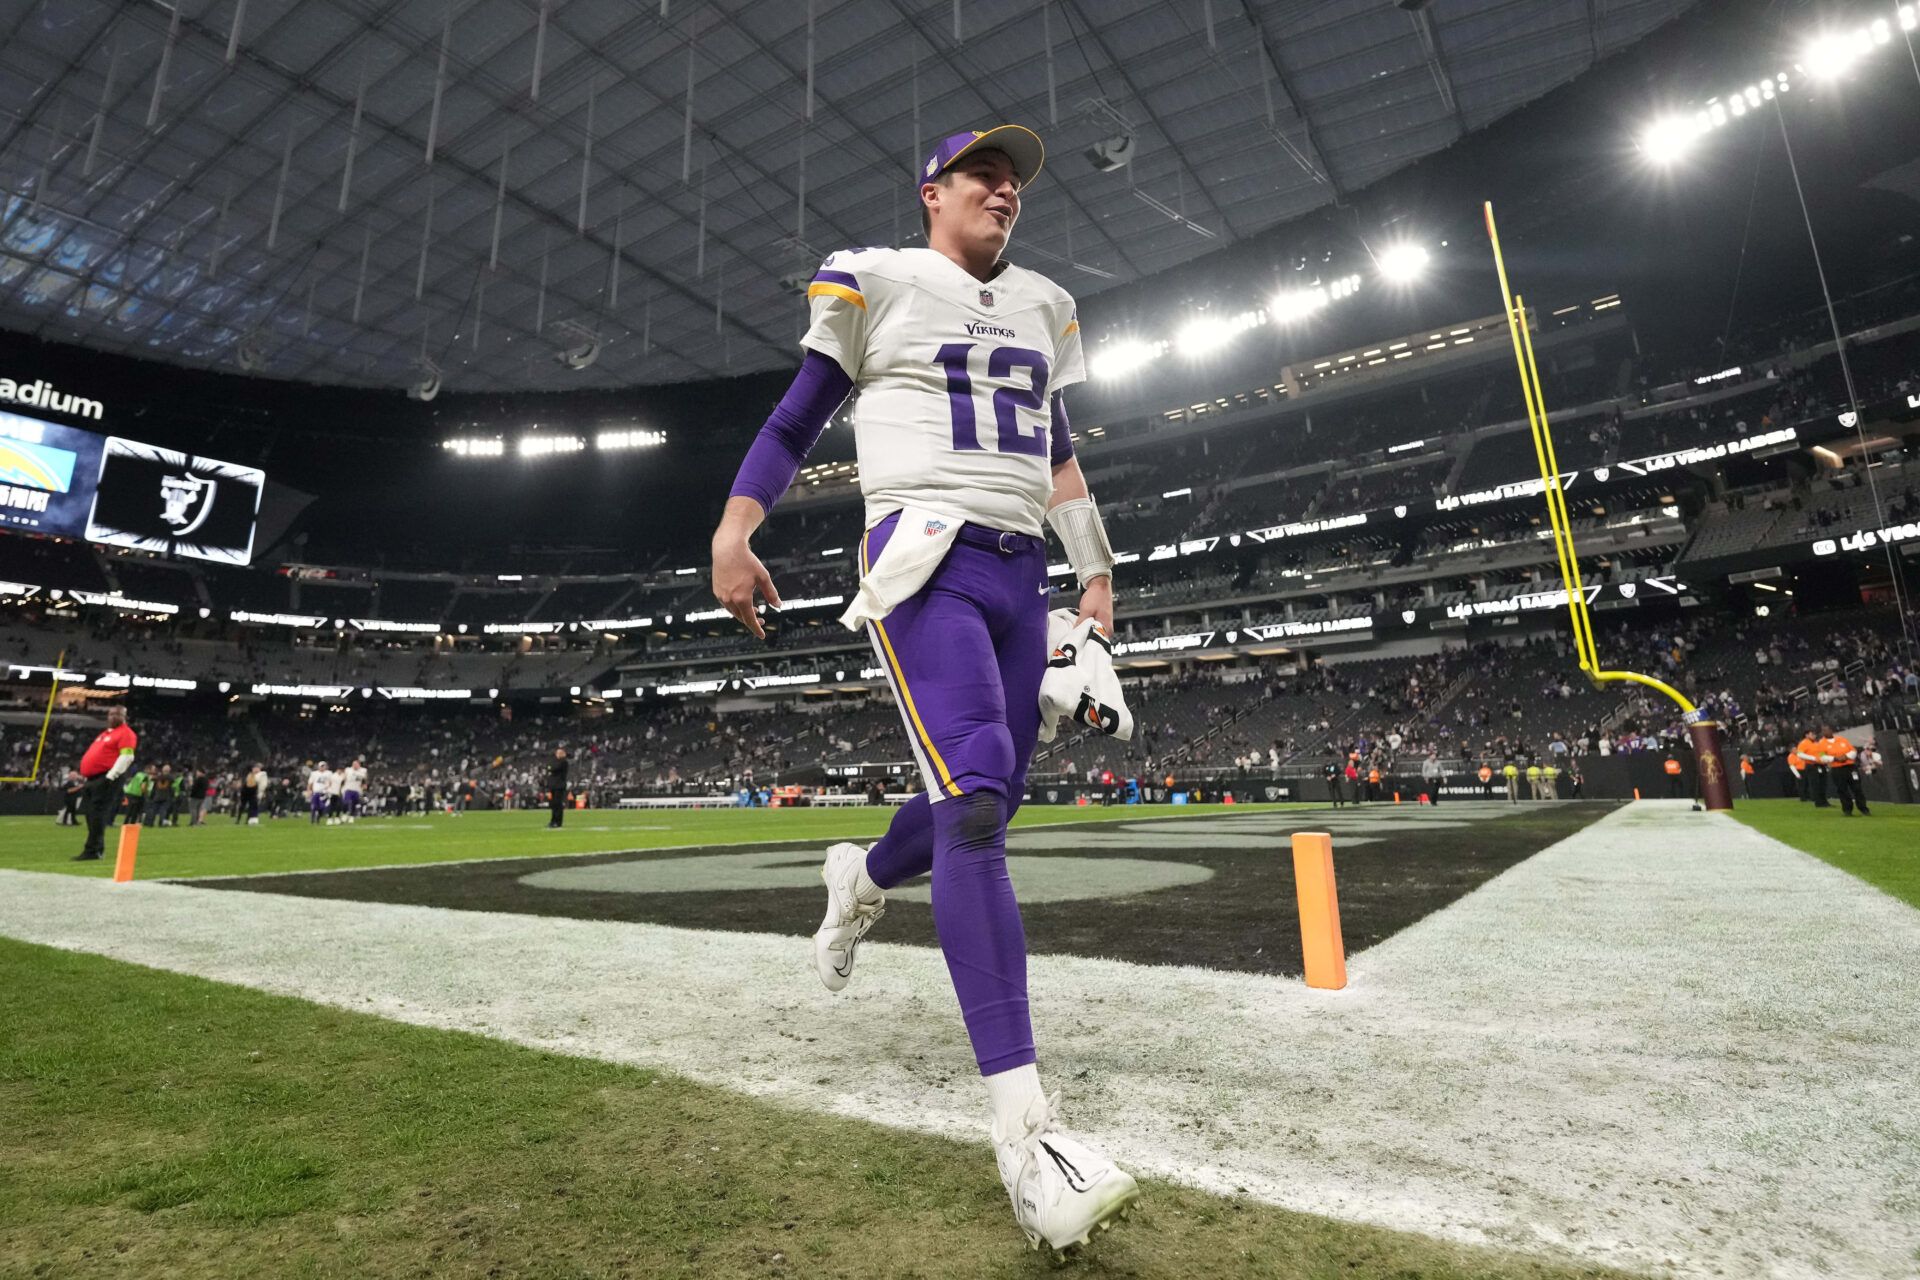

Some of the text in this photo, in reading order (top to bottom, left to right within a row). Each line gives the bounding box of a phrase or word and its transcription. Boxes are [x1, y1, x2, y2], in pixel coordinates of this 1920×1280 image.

[933, 344, 1048, 459] 12
[1646, 428, 1797, 472] LAS VEGAS RAIDERS
[1460, 487, 1502, 506] VEGAS
[1265, 514, 1368, 540] LAS VEGAS RAIDERS
[1473, 599, 1520, 615] VEGAS
[1263, 616, 1373, 640] LAS VEGAS RAIDERS
